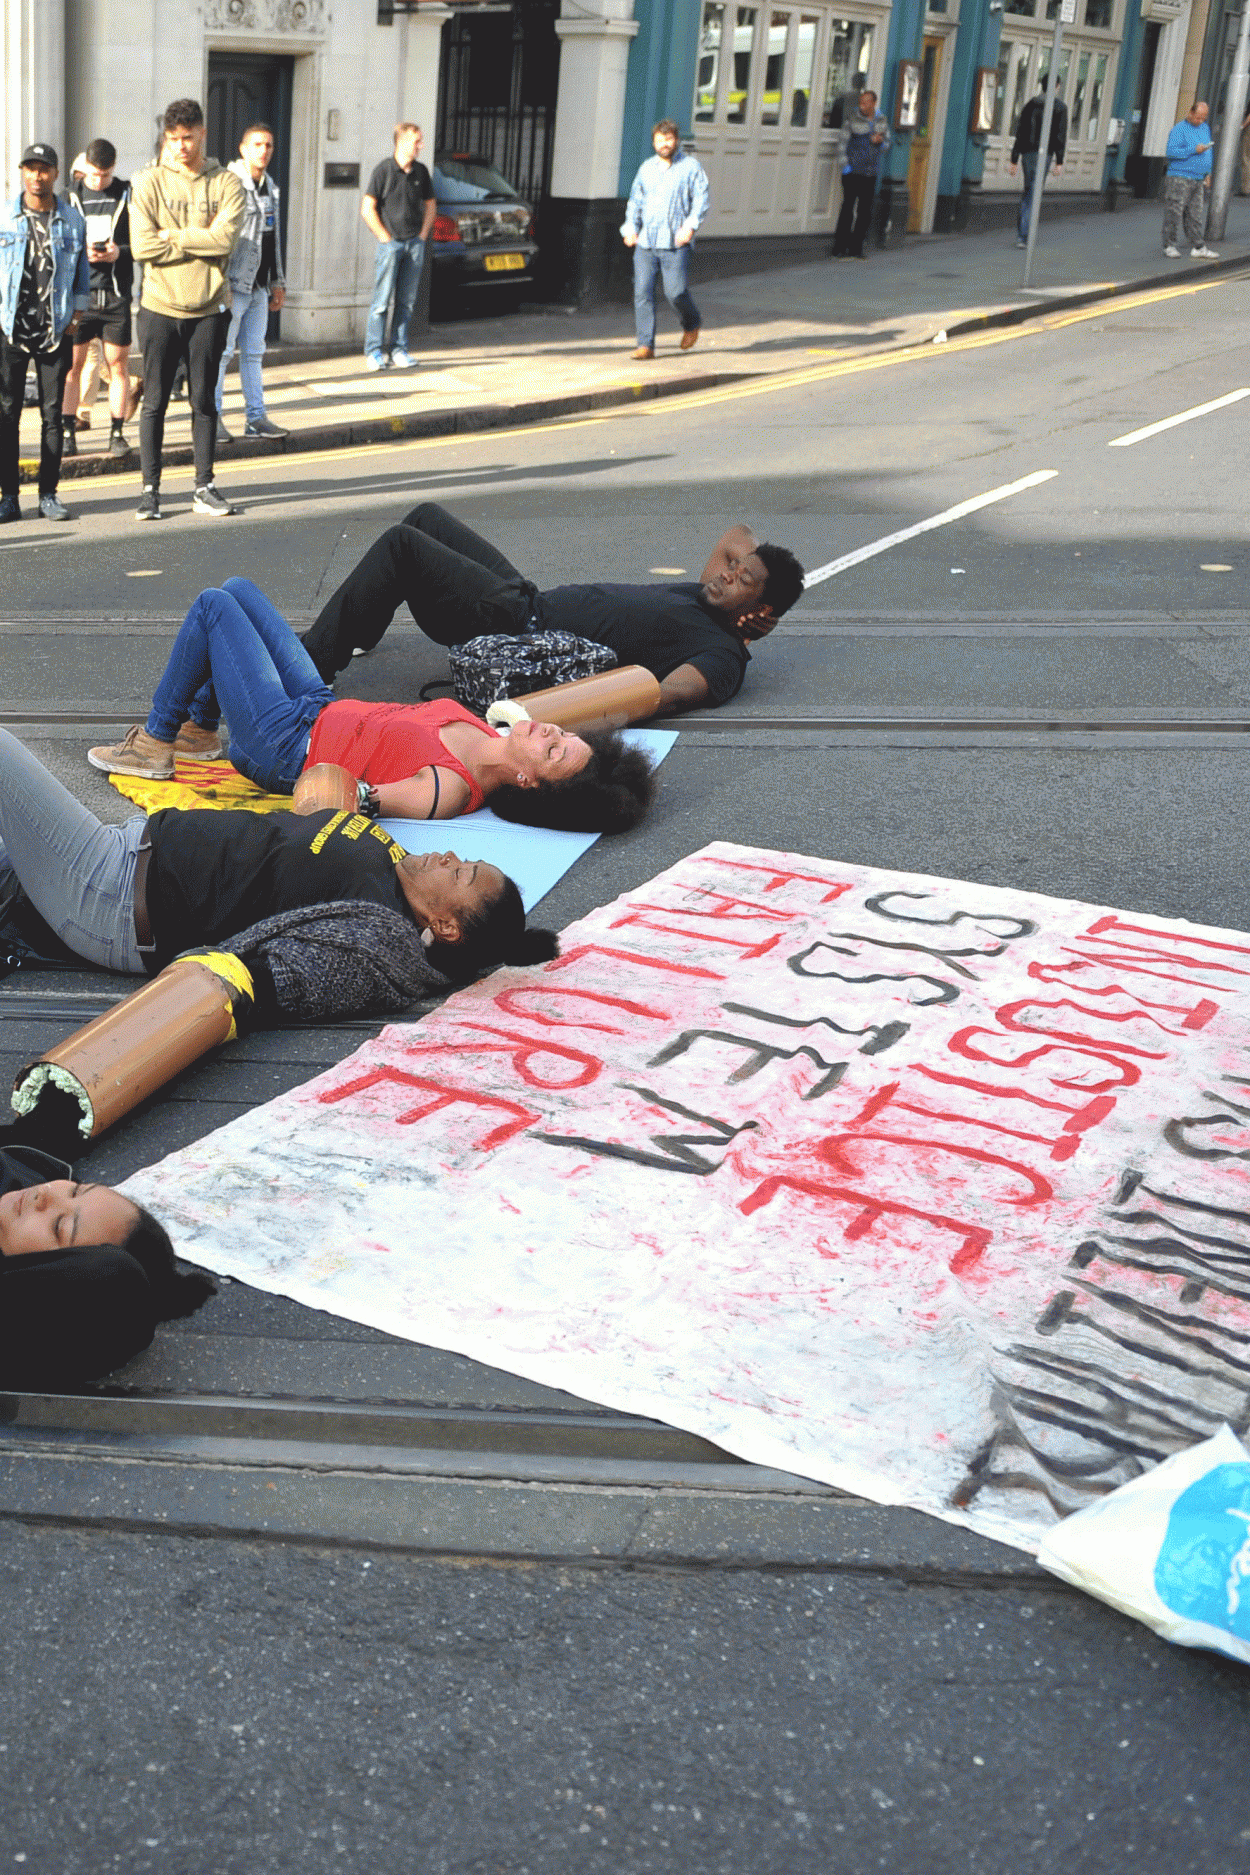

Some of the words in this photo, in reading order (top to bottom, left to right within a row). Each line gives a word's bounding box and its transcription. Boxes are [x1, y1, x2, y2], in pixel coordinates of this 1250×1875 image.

[319, 857, 853, 1151] FAILURE
[526, 891, 1039, 1175] SYSTEM
[736, 915, 1250, 1274] INJUSTICE
